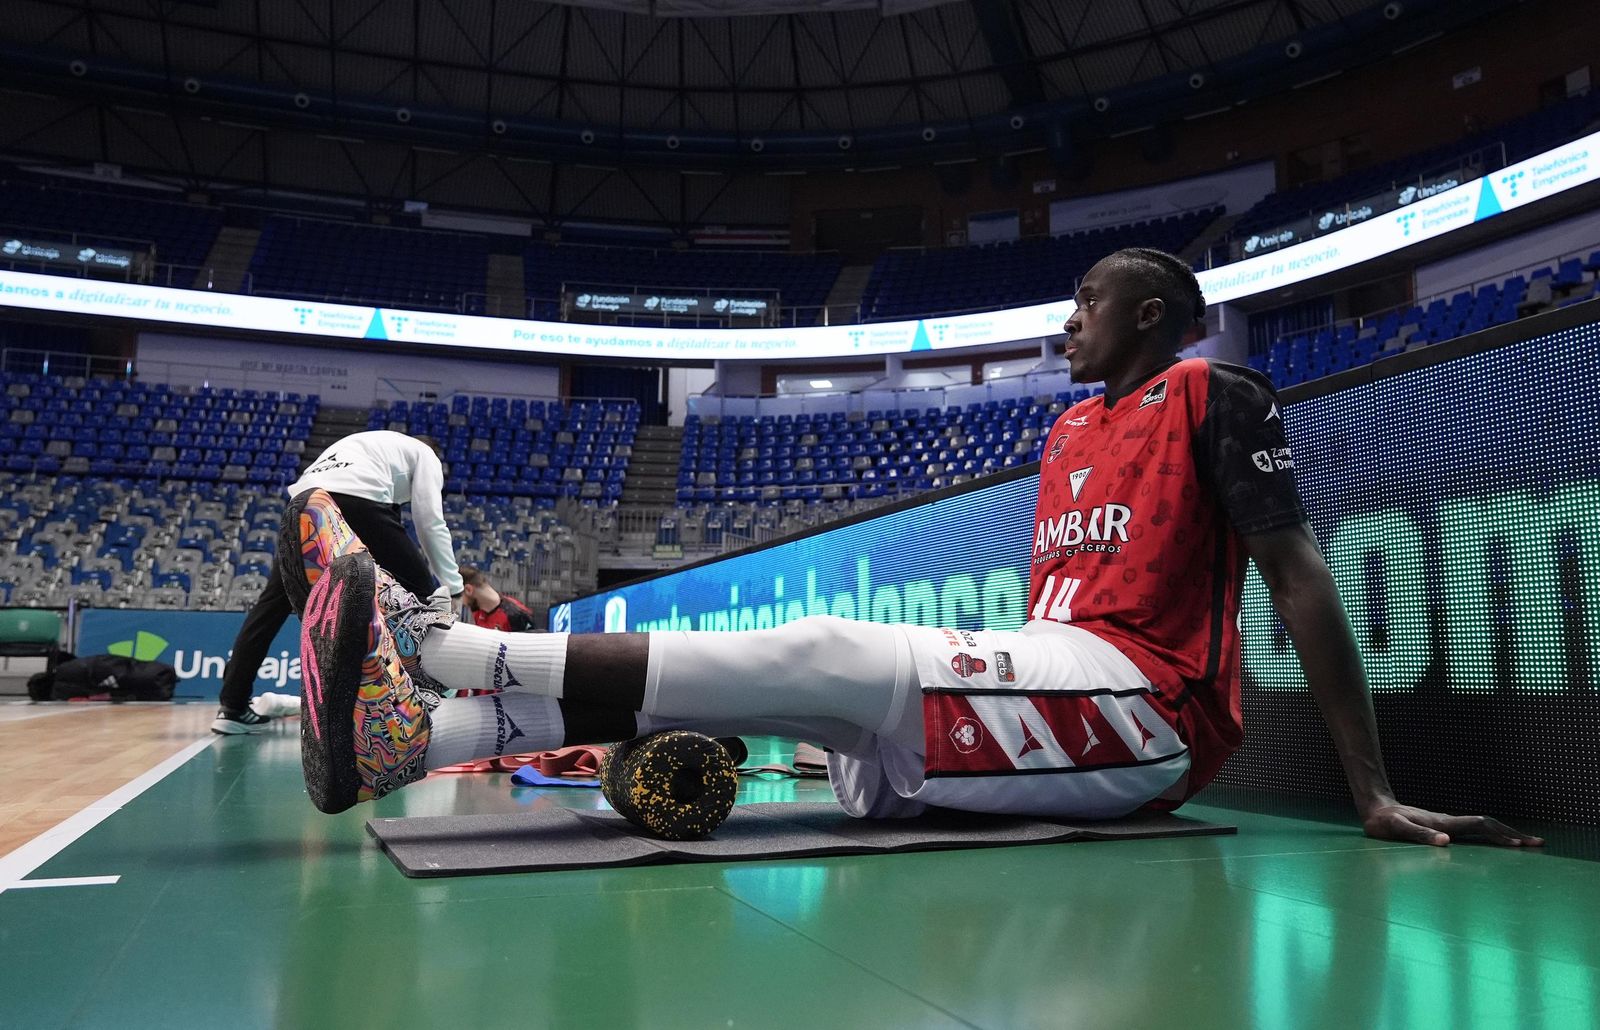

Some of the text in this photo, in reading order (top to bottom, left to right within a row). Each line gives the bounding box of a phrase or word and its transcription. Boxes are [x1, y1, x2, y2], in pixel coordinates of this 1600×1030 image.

[1532, 150, 1589, 176] Telefónica
[1532, 164, 1588, 190] Empresas
[1335, 206, 1373, 225] Uncaja
[1271, 263, 1285, 277] tu
[55, 289, 65, 299] a
[68, 288, 151, 308] digitalizar
[154, 297, 171, 310] tu
[1046, 312, 1069, 325] Por
[513, 329, 536, 342] Por
[540, 333, 563, 344] eso
[567, 333, 581, 344] te
[585, 335, 652, 349] ayudamos
[656, 339, 664, 348] a
[667, 336, 731, 350] digitalizar
[735, 338, 747, 349] tu
[304, 461, 354, 476] RCURY
[1031, 575, 1082, 623] 14
[173, 649, 302, 688] Unaja
[493, 642, 508, 690] MERCU
[996, 652, 1008, 676] acb
